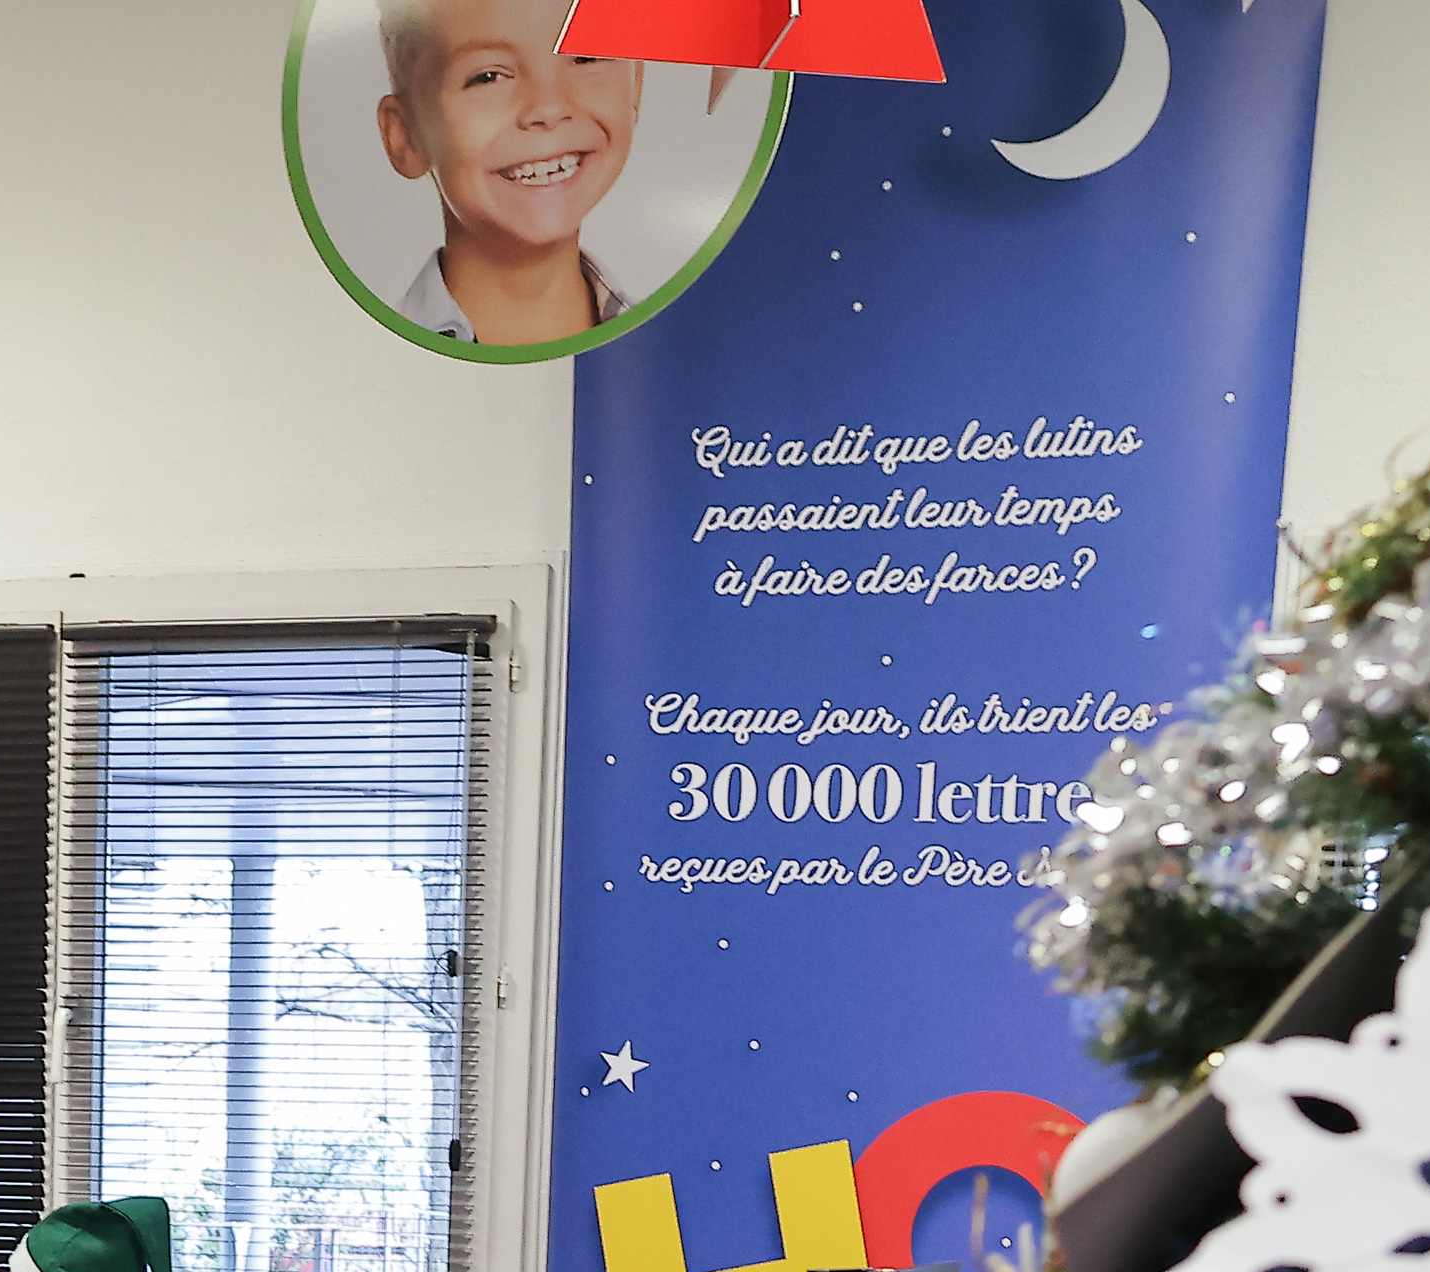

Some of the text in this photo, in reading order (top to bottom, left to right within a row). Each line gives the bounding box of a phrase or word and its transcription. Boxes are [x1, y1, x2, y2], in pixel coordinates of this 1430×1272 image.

[692, 416, 1142, 478] Qui a dit que les lutins
[693, 486, 1121, 542] passaient leur temps
[714, 560, 744, 596] à
[740, 555, 852, 607] faire
[854, 554, 931, 594] des
[923, 551, 1067, 605] farces
[644, 691, 1158, 745] Chaque jour, ils trient les
[667, 761, 1100, 824] 30 000 lettre
[639, 854, 772, 894] reçues
[765, 856, 858, 895] par
[858, 846, 897, 886] le
[902, 845, 1009, 885] Père
